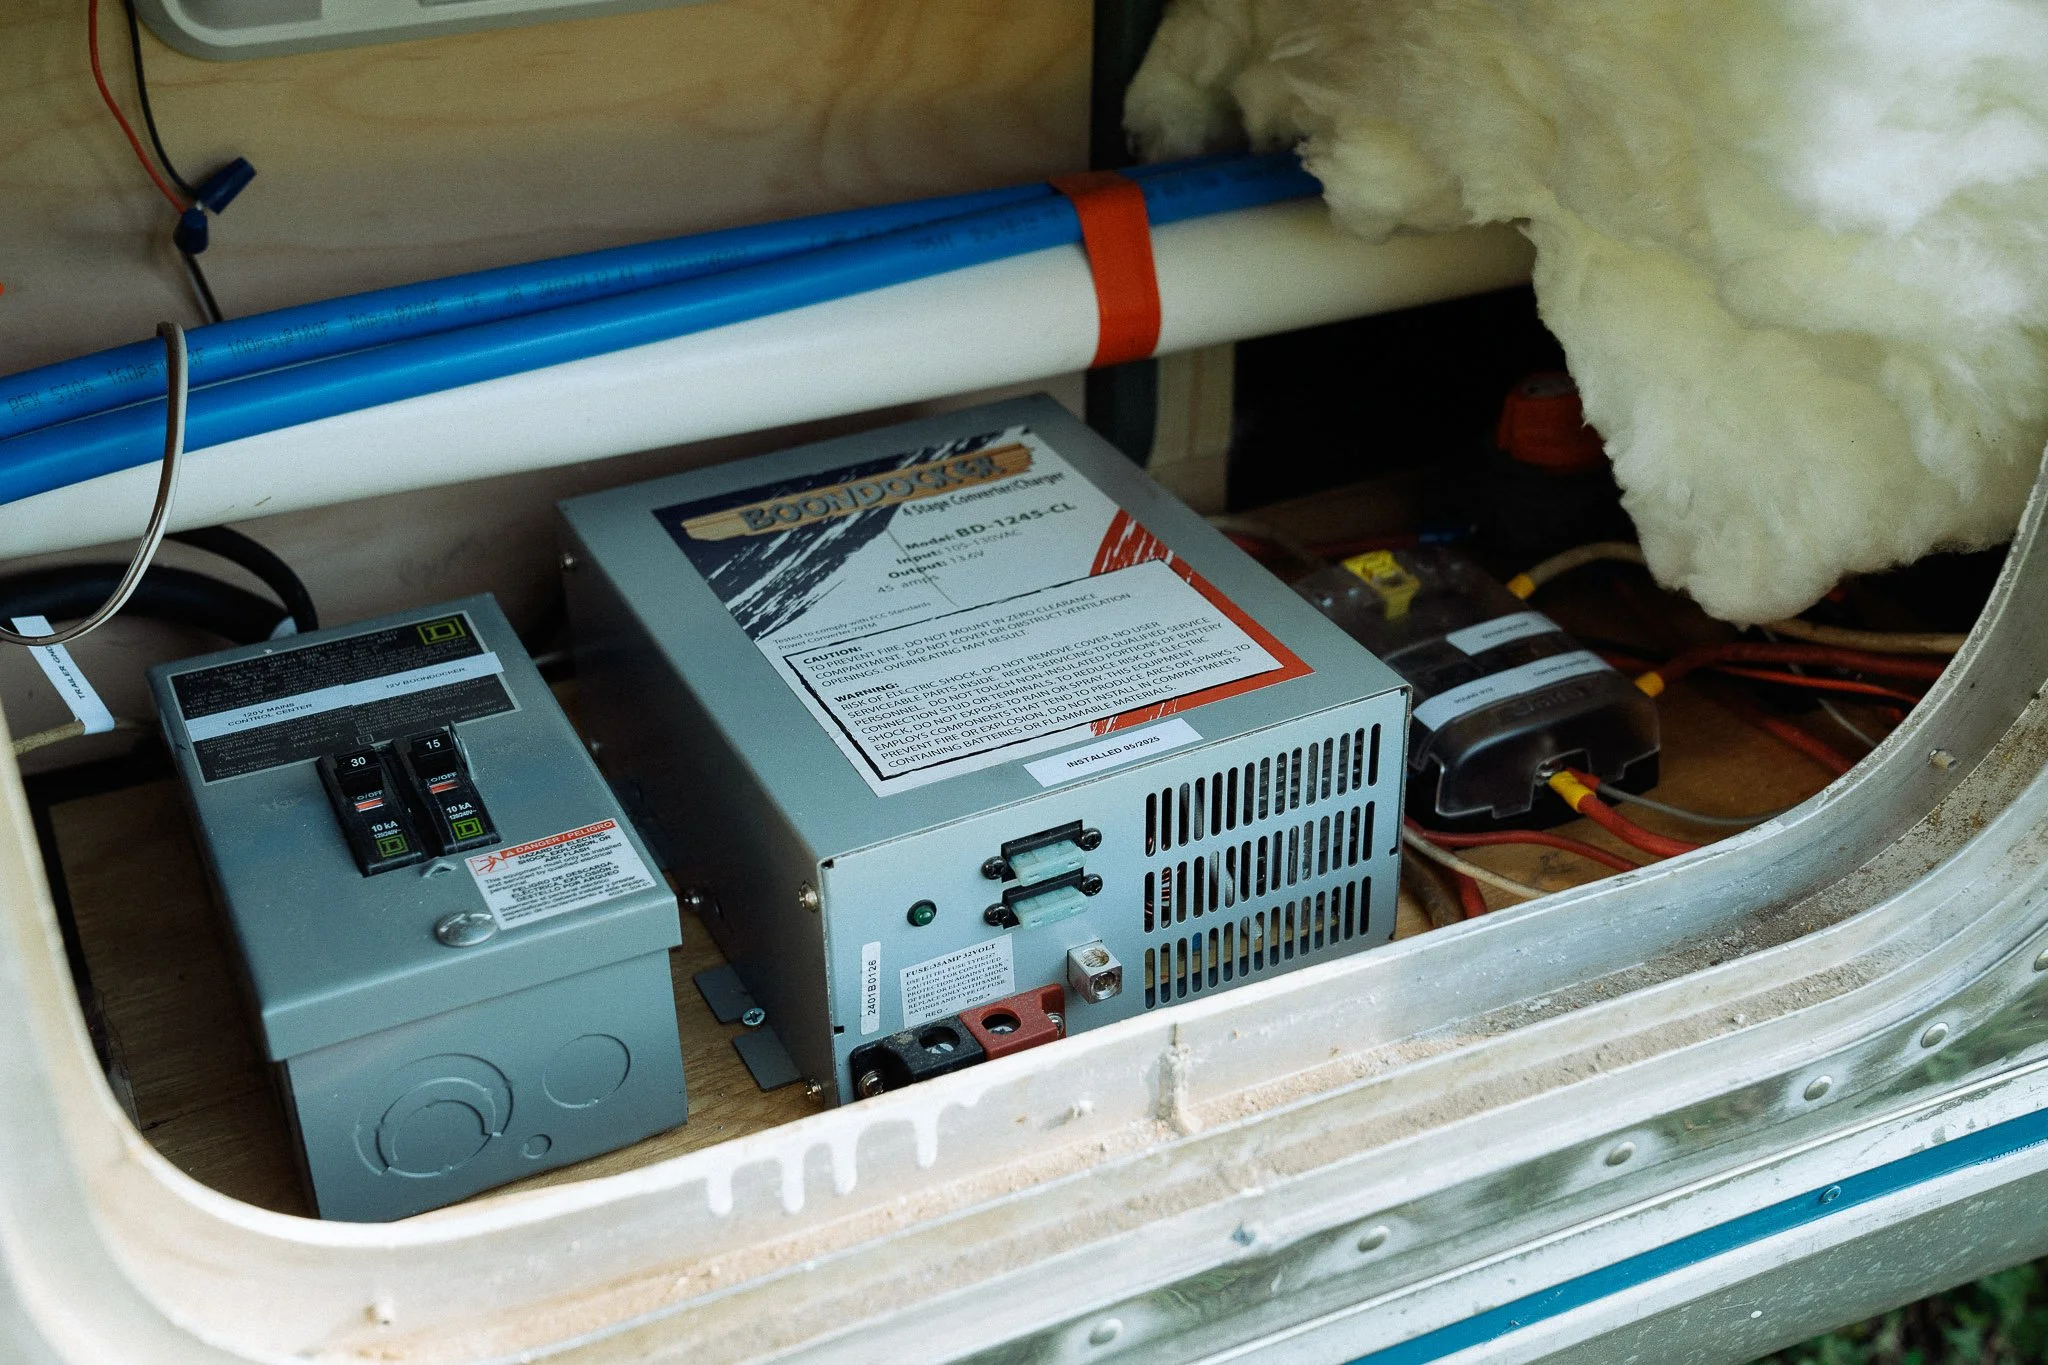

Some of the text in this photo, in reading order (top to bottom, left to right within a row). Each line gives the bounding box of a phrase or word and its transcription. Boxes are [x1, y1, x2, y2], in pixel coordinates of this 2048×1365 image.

[740, 454, 999, 531] BOONDOCKER
[903, 472, 1064, 516] 4 Stage Converter/Charger
[896, 549, 943, 564] Input:
[905, 535, 954, 550] Model:
[876, 574, 940, 593] 45 amps
[887, 560, 948, 579] Output:
[773, 634, 803, 644] Tested
[815, 624, 847, 634] comply
[849, 618, 869, 626] with
[888, 602, 931, 615] Standards
[808, 664, 825, 672] TO
[826, 651, 875, 668] PREVENT
[904, 639, 923, 648] DO
[924, 633, 947, 642] NOT
[949, 621, 990, 636] MOUNT
[1006, 610, 1035, 622] ZERO
[1036, 594, 1095, 613] CLEARANCE
[907, 648, 925, 657] DO
[926, 641, 949, 651] NOT
[952, 631, 989, 644] COVER
[1007, 611, 1062, 629] OBSTRUCT
[1063, 593, 1131, 615] VENTILATION
[778, 641, 806, 650] Power
[807, 630, 850, 643] Converter
[803, 647, 862, 664] CAUTION:
[841, 700, 867, 711] RISK
[868, 695, 883, 703] OF
[885, 681, 938, 699] ELECTRIC
[982, 665, 1001, 674] DO
[1001, 658, 1025, 669] NOT
[1027, 646, 1073, 662] REMOVE
[1113, 630, 1131, 638] NO
[1131, 622, 1160, 633] USER
[848, 695, 922, 719] SERVICEABLE
[922, 686, 958, 699] PARTS
[1002, 665, 1036, 678] REFER
[1036, 650, 1094, 668] SERVICING
[1111, 630, 1166, 648] QUALIFIED
[1167, 617, 1210, 632] SERVICE
[884, 648, 961, 671] OVERHEATING
[962, 641, 985, 651] MAY
[928, 698, 947, 707] DO
[949, 691, 972, 701] NOT
[973, 680, 1015, 694] TOUCH
[1015, 656, 1105, 684] NON-INSULATED
[1105, 641, 1160, 659] PORTIONS
[1177, 623, 1222, 639] BATTERY
[45, 645, 86, 700] TRAILER GND
[384, 666, 467, 689] 12V BOONDOCKER
[861, 710, 938, 734] CONNECTION
[939, 702, 971, 713] STUD
[1073, 662, 1116, 678] REDUCE
[1118, 655, 1143, 665] RISK
[1143, 650, 1157, 658] OF
[1159, 636, 1209, 654] ELECTRIC
[834, 683, 899, 702] WARNING:
[913, 722, 932, 731] DO
[933, 714, 957, 725] NOT
[959, 702, 1005, 718] EXPOSE
[1003, 698, 1021, 706] TO
[1022, 690, 1051, 702] RAIN
[1051, 685, 1069, 693] OR
[1105, 668, 1131, 678] THIS
[1131, 650, 1194, 671] EQUIPMENT
[227, 702, 313, 727] CONTROL CENTER
[243, 701, 295, 718] 120V MAINS
[874, 733, 929, 751] EMPLOYS
[930, 710, 1011, 736] COMPONENTS
[1010, 702, 1040, 714] THAT
[1041, 694, 1073, 706] TEND
[1072, 689, 1090, 697] TO
[1090, 673, 1145, 692] PRODUCE
[1146, 666, 1174, 677] ARCS
[881, 741, 932, 759] PREVENT
[934, 734, 960, 745] FIRE
[961, 729, 979, 737] OR
[1047, 706, 1067, 714] DO
[1067, 698, 1092, 709] NOT
[1093, 686, 1139, 702] INSTALL
[1138, 681, 1152, 689] IN
[1152, 657, 1241, 684] COMPARTMENTS
[426, 739, 441, 750] 15
[888, 744, 962, 767] CONTAINING
[963, 727, 1023, 747] BATTERIES
[1024, 722, 1042, 731] OR
[1042, 703, 1112, 726] FLAMMABLE
[350, 756, 366, 767] 30
[1067, 737, 1160, 768] INSTALLED 05/2025
[446, 801, 472, 815] 10 kA
[371, 820, 398, 833] 10 kA
[516, 822, 612, 852] DANGER PELIGRO
[518, 848, 552, 860] HAZARD
[566, 832, 605, 846] ELECTRIC
[545, 847, 590, 863] ARC FLASH
[867, 959, 877, 1016] 2401B0126
[907, 979, 953, 998] PROTECTION
[955, 968, 985, 982] AGAINST
